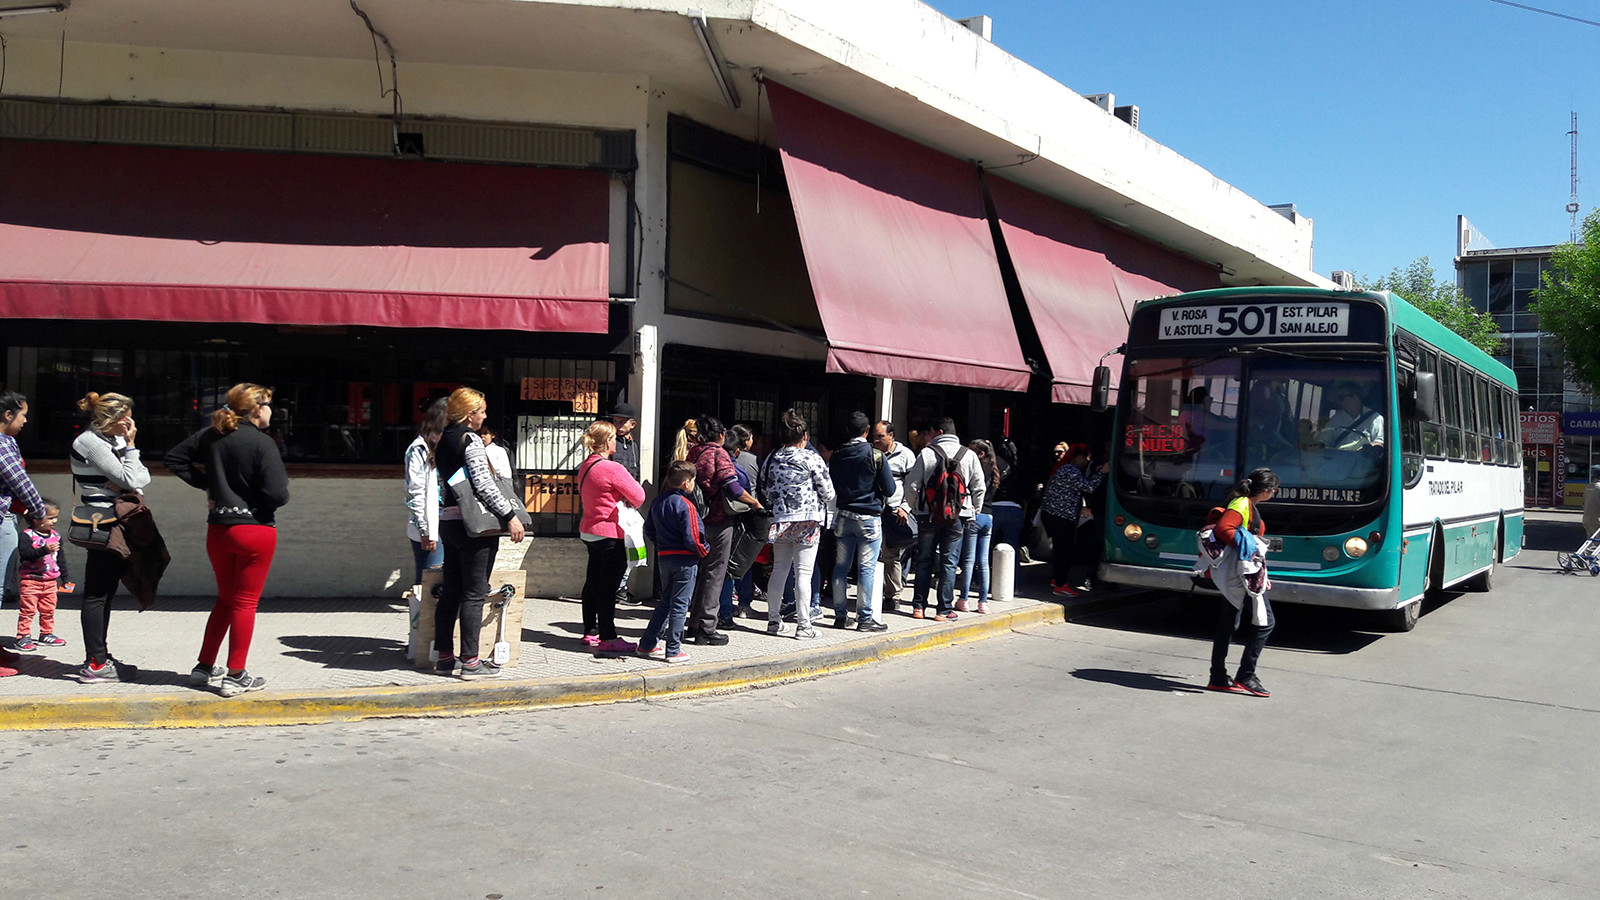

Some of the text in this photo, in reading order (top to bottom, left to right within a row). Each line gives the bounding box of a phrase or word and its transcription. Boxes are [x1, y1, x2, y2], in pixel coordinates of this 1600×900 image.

[1172, 309, 1208, 320] V. ROSA
[1282, 306, 1338, 318] EST. PILAR
[1215, 305, 1278, 336] 501
[1164, 324, 1213, 336] V. ASTOLFI
[1280, 322, 1339, 334] SAN ALEJO
[1142, 424, 1184, 438] ALEJO
[528, 435, 573, 445] COMPLETA
[1272, 487, 1354, 502] ADO DEL PILAR
